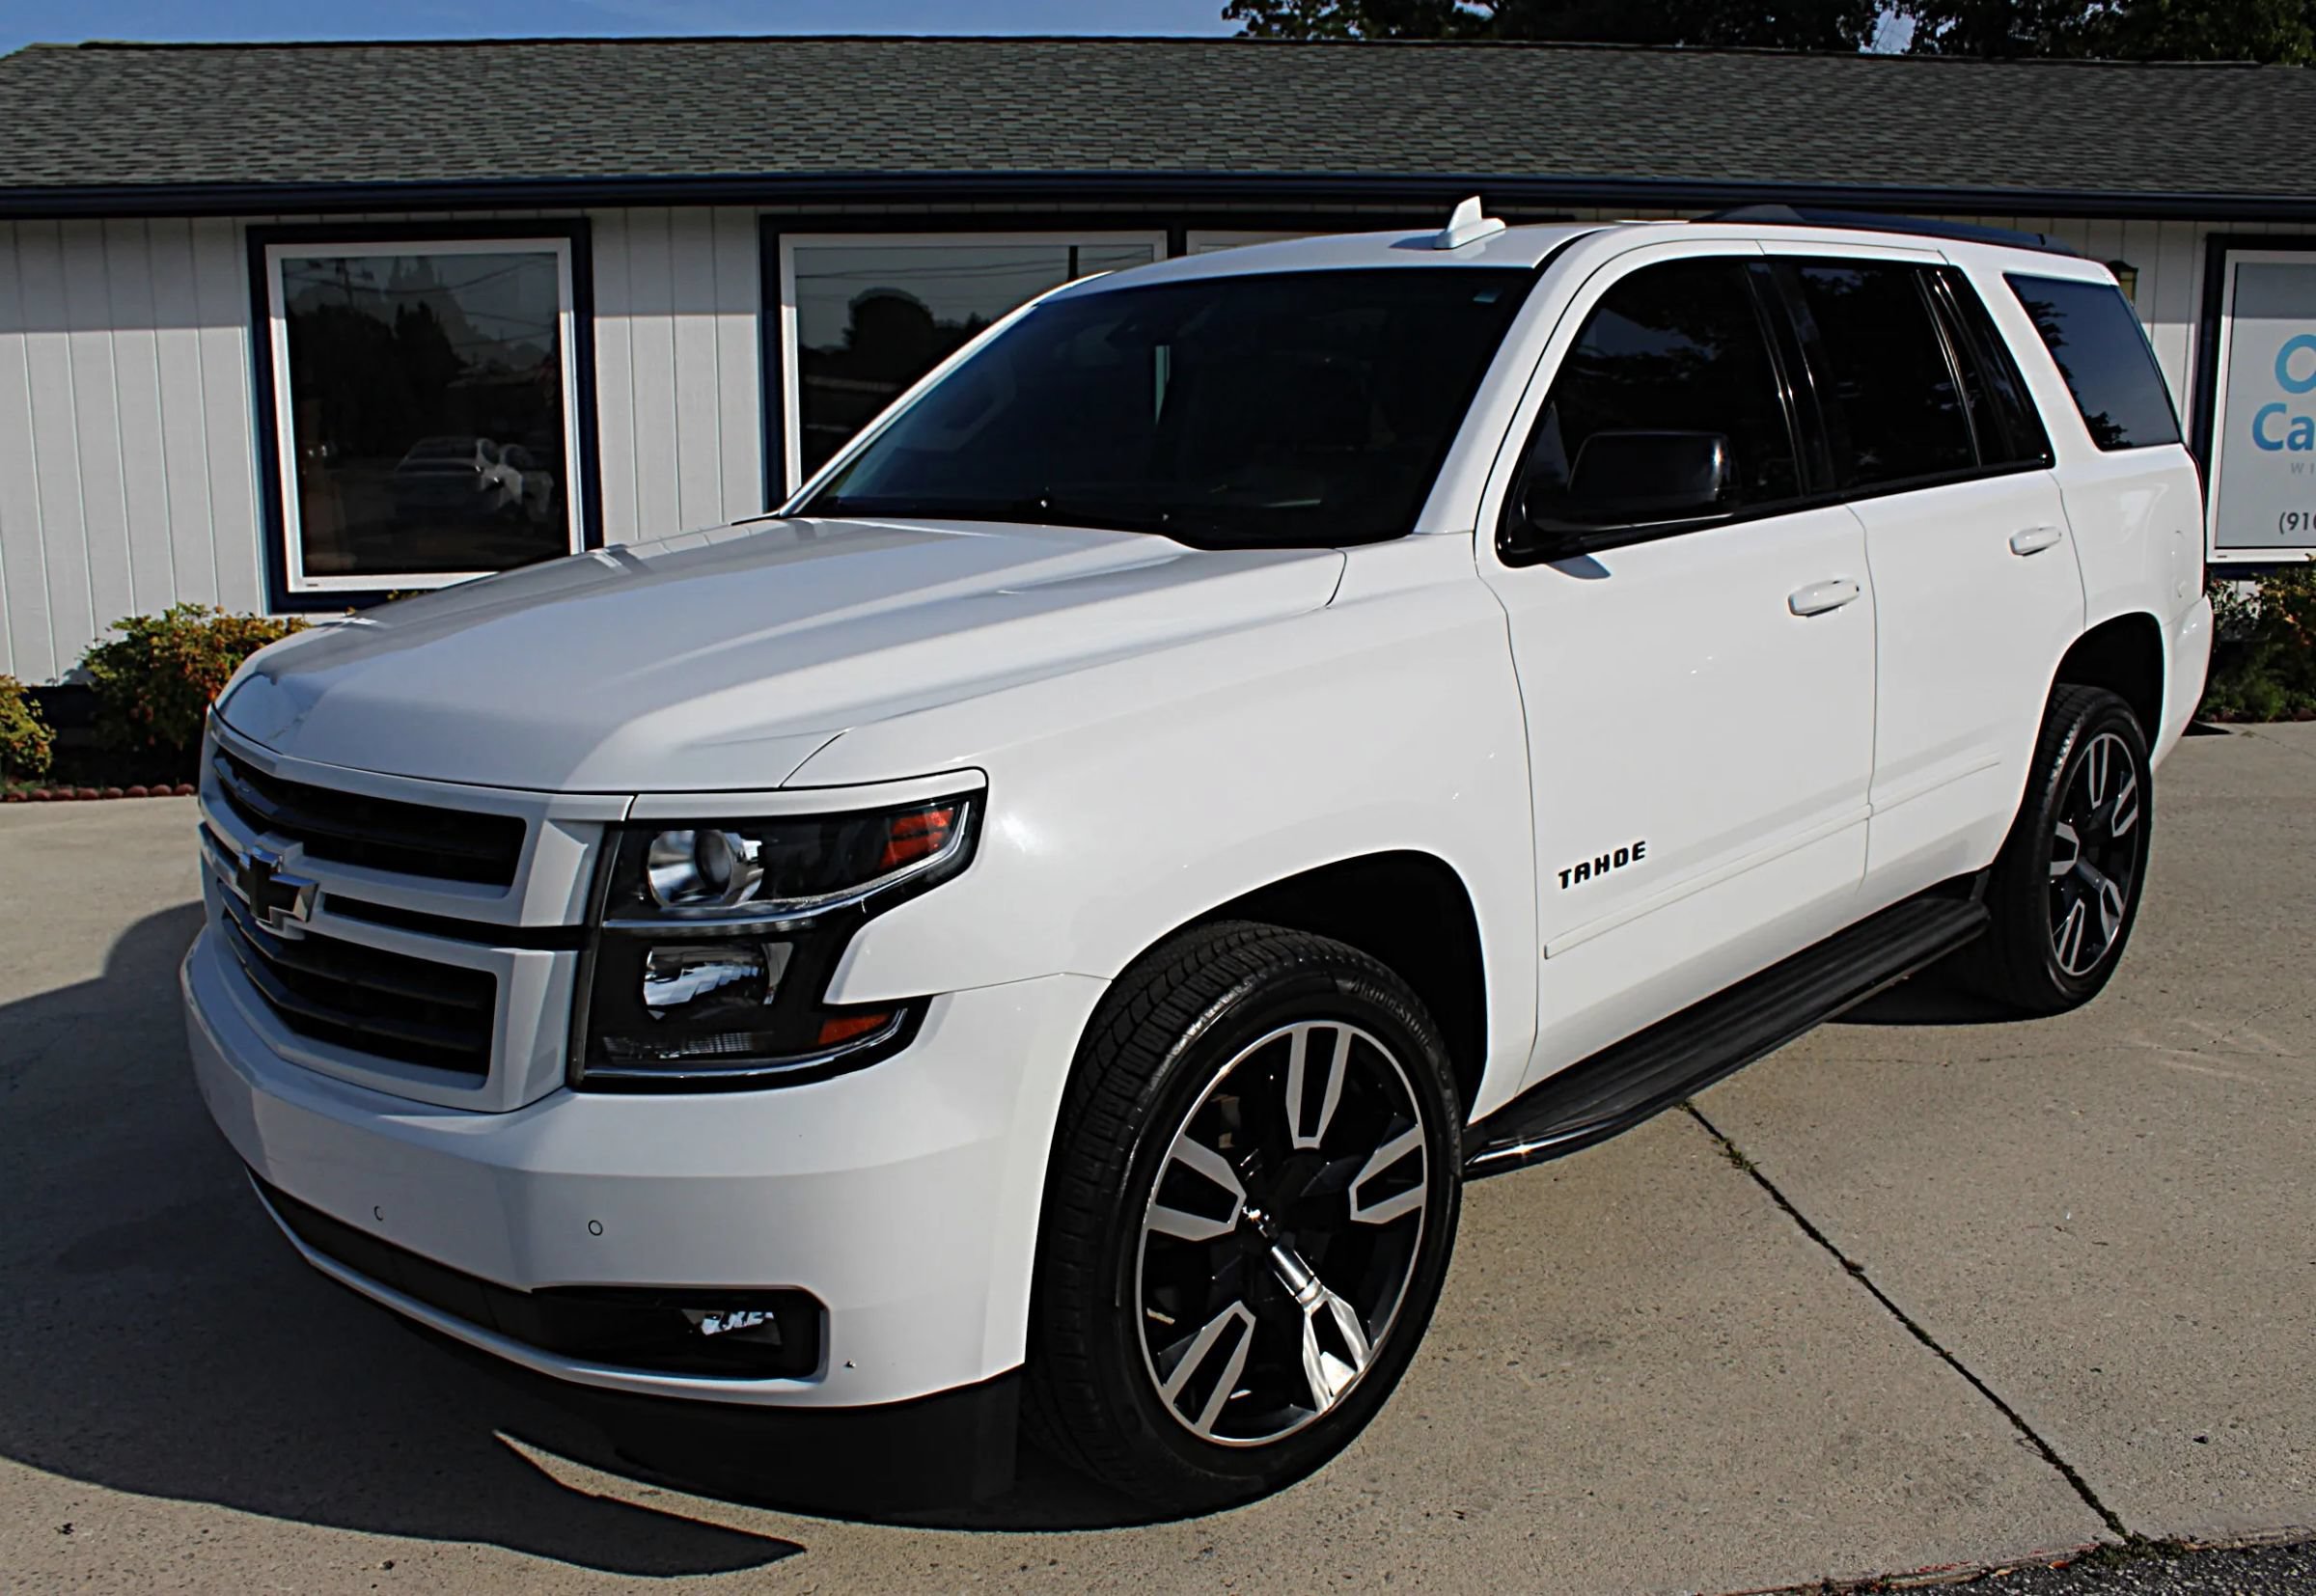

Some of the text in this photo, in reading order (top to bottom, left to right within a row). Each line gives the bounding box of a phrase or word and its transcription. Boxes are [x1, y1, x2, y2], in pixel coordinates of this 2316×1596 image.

[2252, 402, 2315, 452] Ca
[2278, 511, 2316, 535] (91
[1558, 840, 1645, 889] TAHOE
[1349, 974, 1435, 1055] BRIDGESTONE
